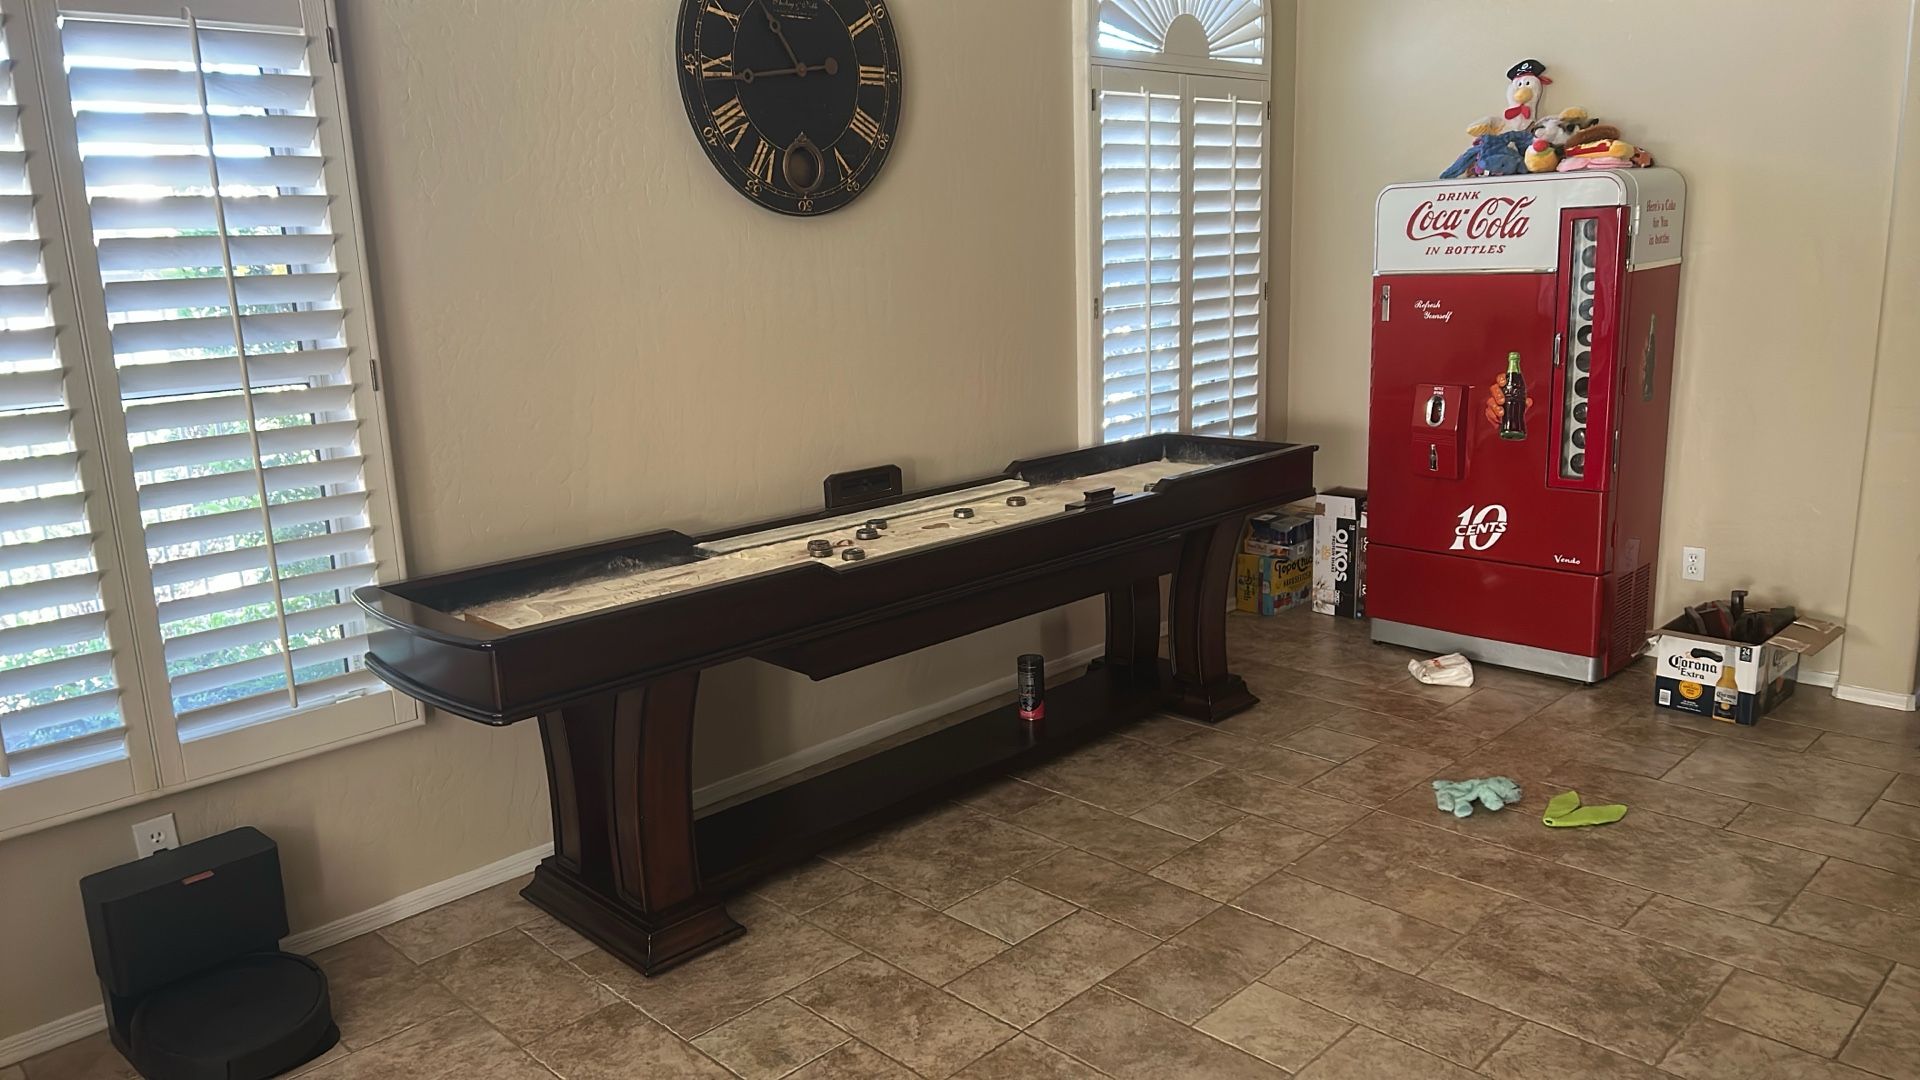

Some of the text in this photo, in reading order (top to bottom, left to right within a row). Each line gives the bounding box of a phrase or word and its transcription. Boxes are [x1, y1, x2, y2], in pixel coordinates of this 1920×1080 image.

[874, 4, 885, 19] 10
[847, 11, 876, 40] II
[684, 53, 696, 75] 45
[859, 64, 885, 87] III
[703, 127, 718, 146] 40
[746, 136, 775, 185] VII
[833, 146, 853, 181] V
[1437, 190, 1481, 202] DRINK
[1406, 195, 1537, 241] Coca-Cola
[1425, 244, 1507, 256] IN BOTTLES
[1414, 299, 1441, 311] Refresh
[1423, 311, 1453, 323] Yourself
[1449, 504, 1508, 551] 10
[1454, 521, 1508, 537] CENTS
[1335, 528, 1349, 582] OIKOS
[1553, 554, 1580, 565] Vendo
[1742, 647, 1751, 656] 24
[1668, 654, 1718, 674] Corona
[1680, 667, 1705, 680] Extra
